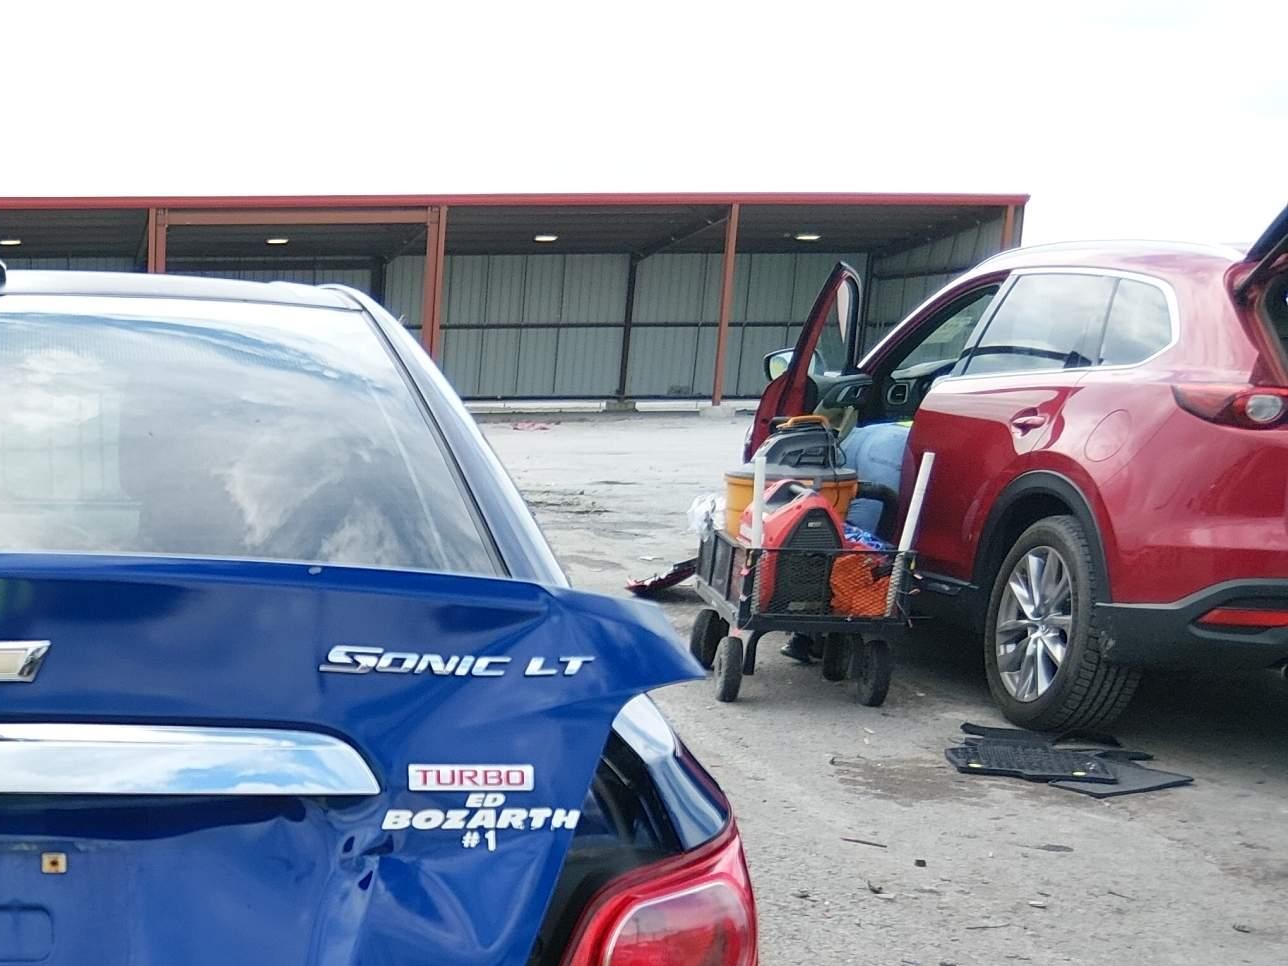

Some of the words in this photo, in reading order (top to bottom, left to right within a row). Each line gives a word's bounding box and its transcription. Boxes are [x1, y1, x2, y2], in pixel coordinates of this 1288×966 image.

[319, 645, 513, 677] SONIC
[524, 655, 596, 677] LT
[415, 769, 525, 786] TURBO
[465, 793, 506, 808] ED
[381, 808, 581, 831] BOZARTH
[461, 830, 497, 852] #1
